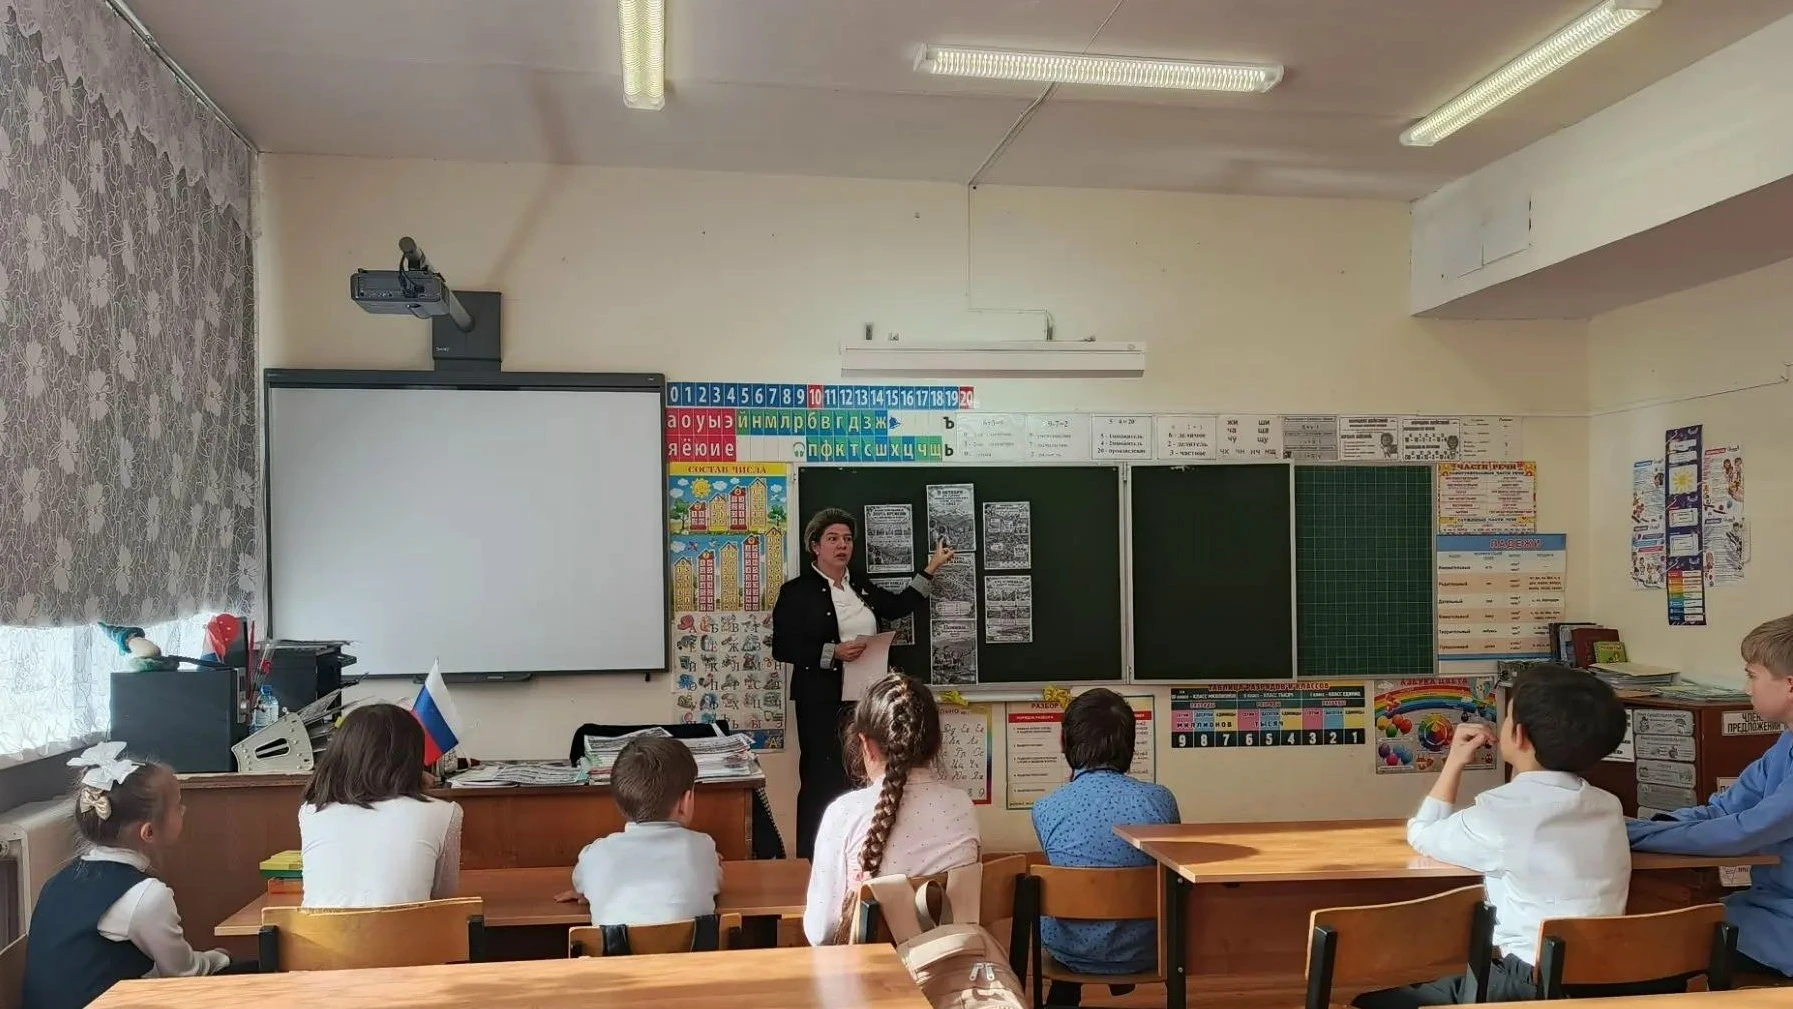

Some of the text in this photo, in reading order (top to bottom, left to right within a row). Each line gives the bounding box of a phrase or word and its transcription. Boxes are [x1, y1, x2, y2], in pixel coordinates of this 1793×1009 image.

[670, 386, 973, 406] 0 1 2 3 4 5 6 7 8 9 10 11 12 13 14 15 16 17 18 19 20
[688, 465, 767, 474] СОСТАВ ЧИСЛА
[769, 738, 778, 748] А
[1179, 731, 1357, 747] 9 8 7 6 5 4 3 2 1
